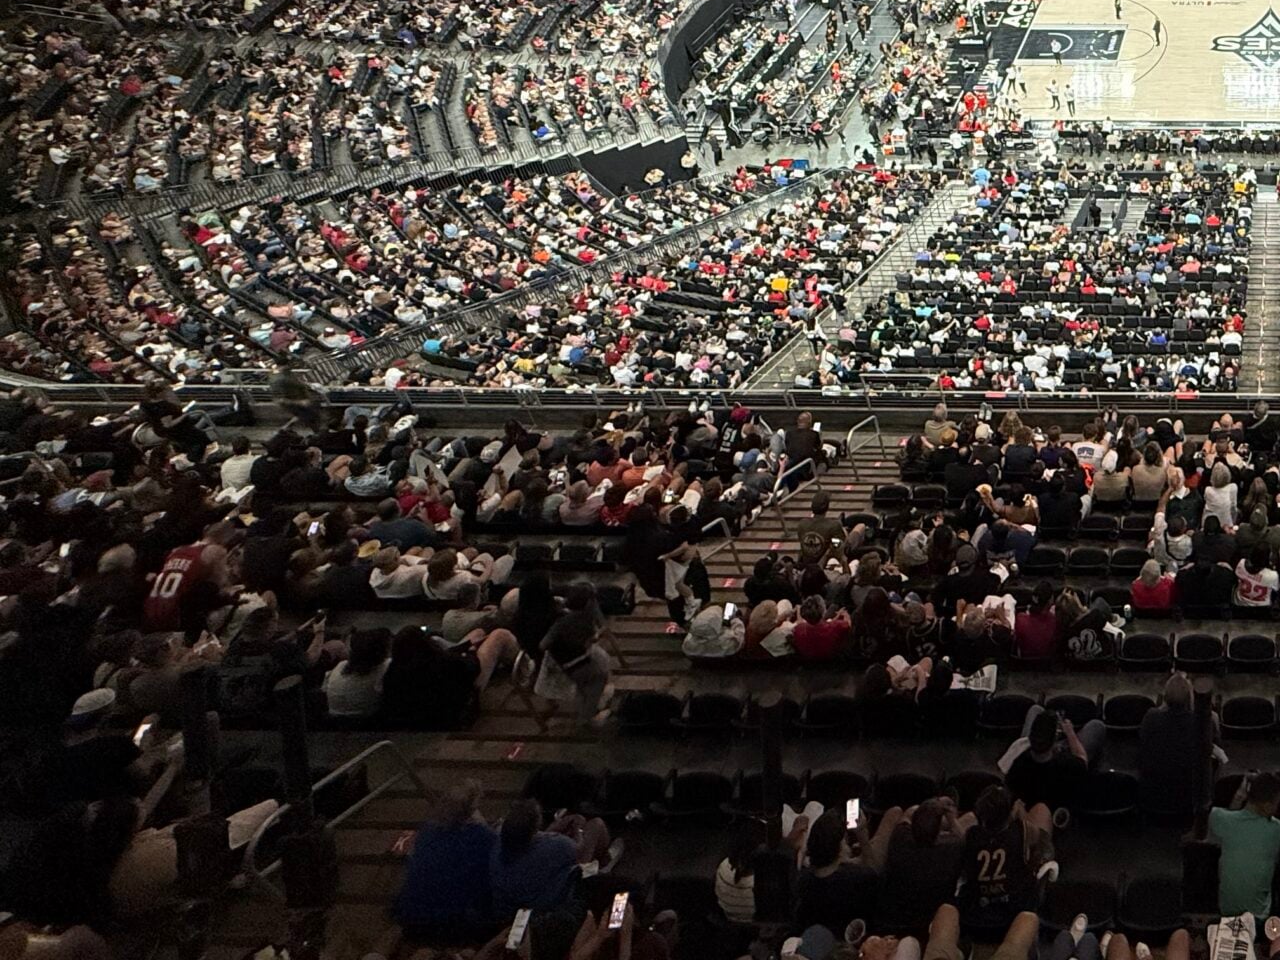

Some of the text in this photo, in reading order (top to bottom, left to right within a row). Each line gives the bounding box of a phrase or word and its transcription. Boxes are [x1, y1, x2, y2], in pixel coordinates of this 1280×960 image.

[149, 572, 184, 598] 10
[1239, 578, 1268, 602] 22
[977, 848, 1007, 881] 22
